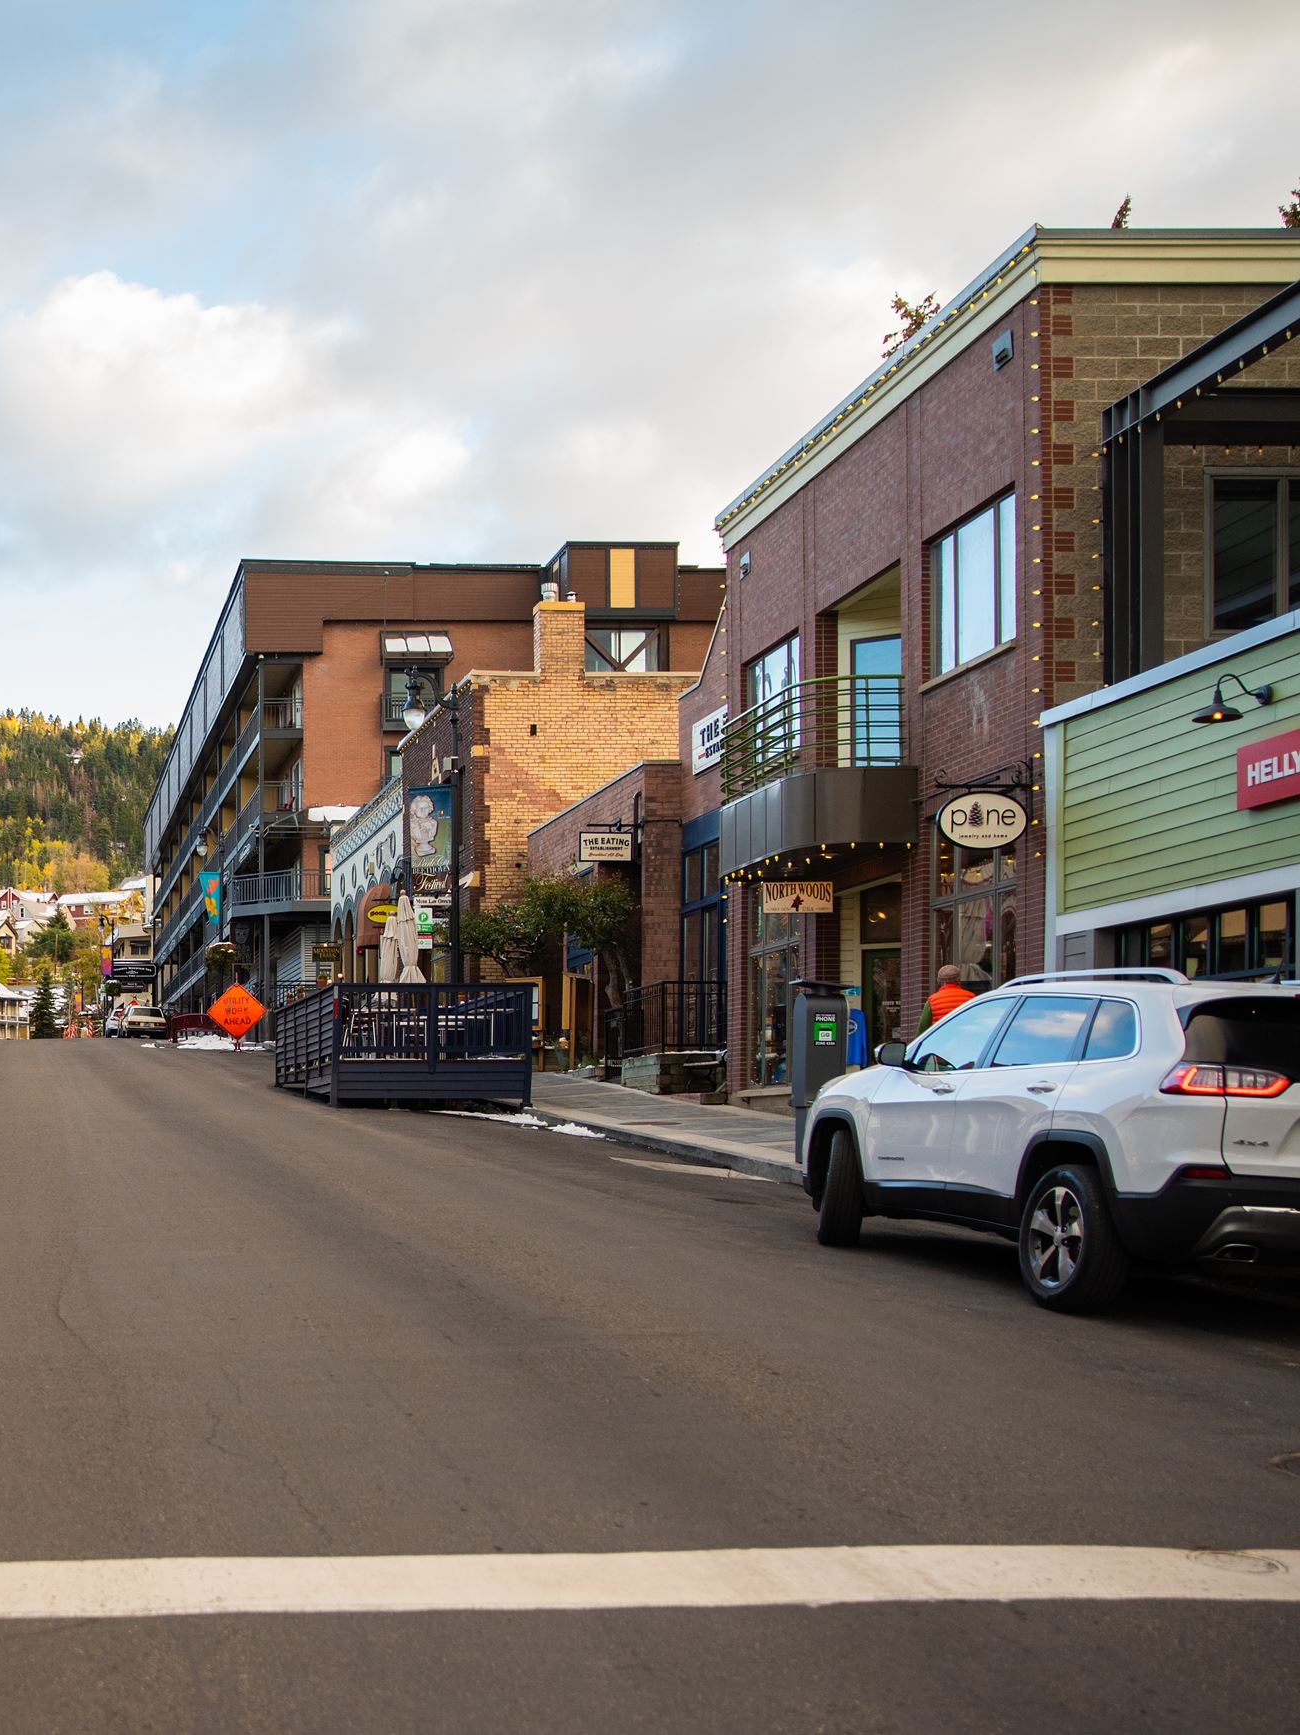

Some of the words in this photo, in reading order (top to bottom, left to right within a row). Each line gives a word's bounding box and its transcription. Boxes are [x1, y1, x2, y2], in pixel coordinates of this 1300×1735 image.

[699, 718, 720, 747] THE
[583, 838, 599, 847] THE
[600, 838, 630, 847] EATING
[414, 872, 449, 891] Festival
[223, 997, 250, 1005] UTILITY
[225, 1007, 249, 1015] WORK
